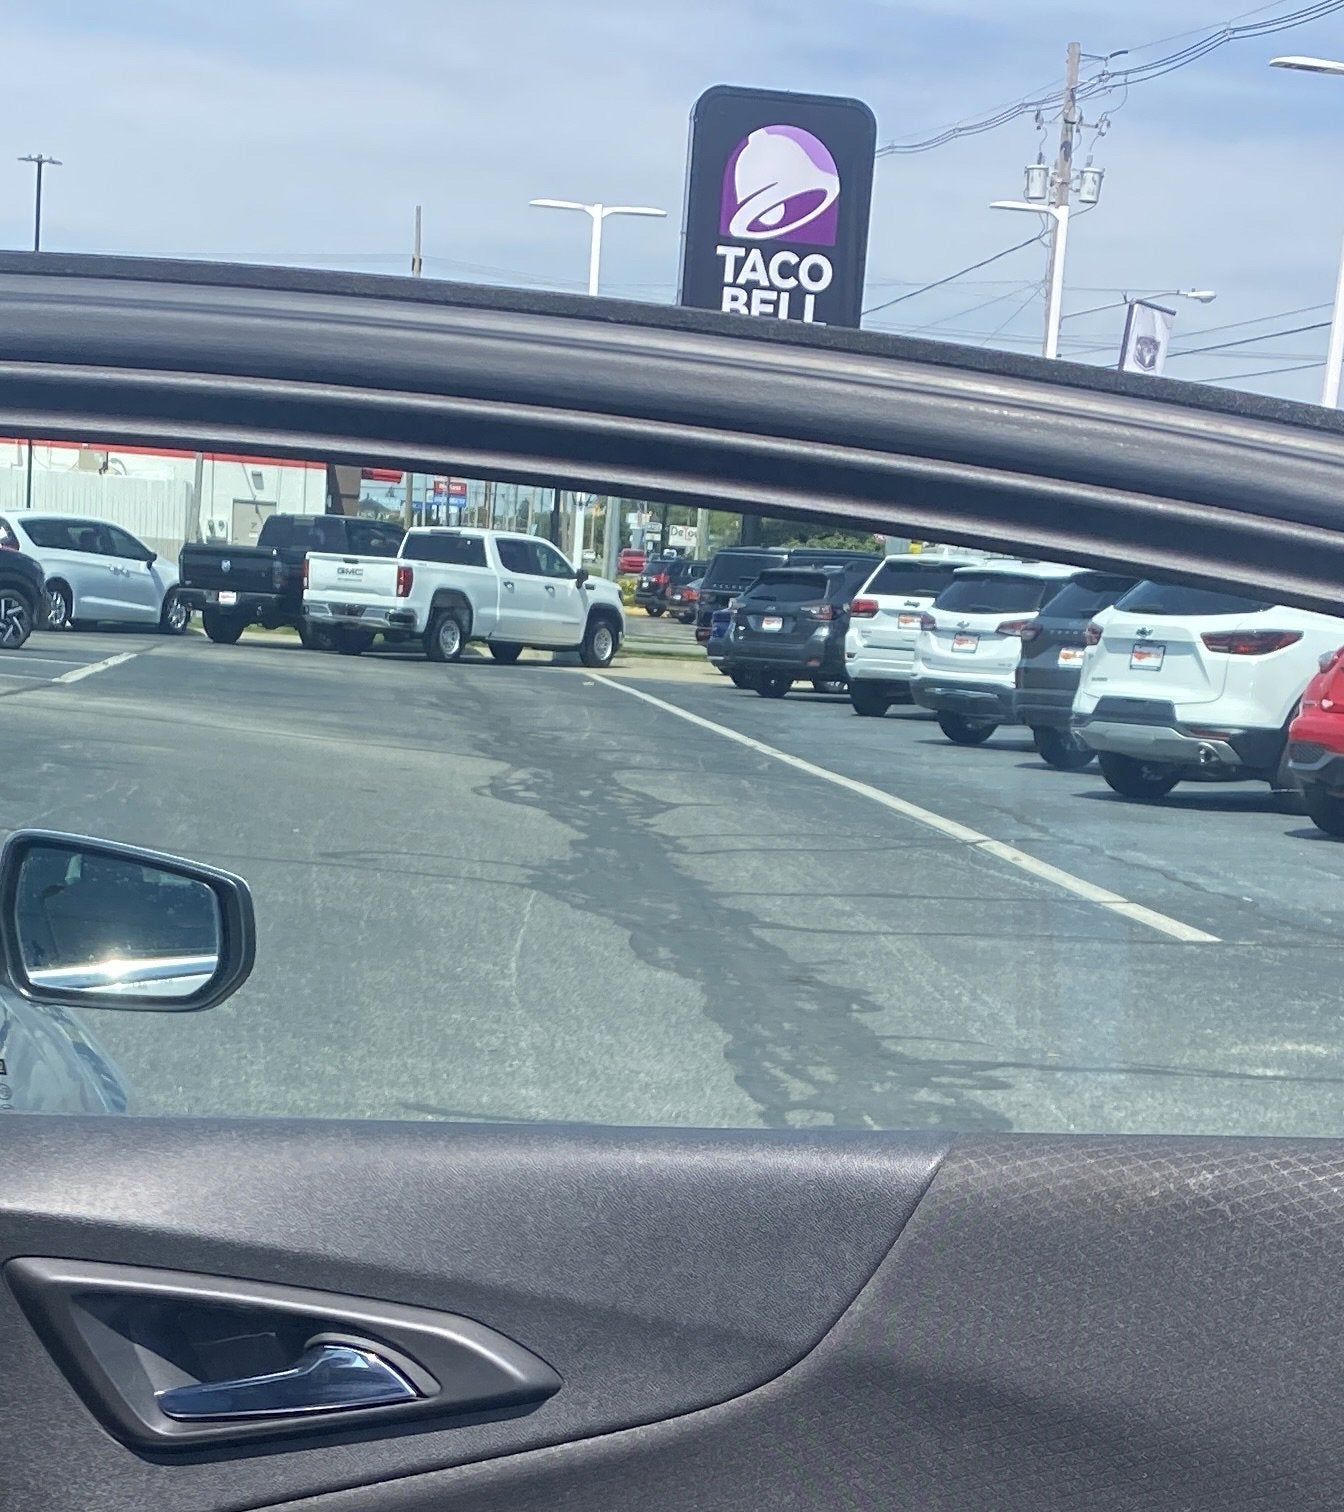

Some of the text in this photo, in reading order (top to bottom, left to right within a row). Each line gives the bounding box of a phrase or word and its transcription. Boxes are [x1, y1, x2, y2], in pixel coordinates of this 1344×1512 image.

[716, 244, 833, 292] TACO
[721, 286, 827, 326] BELL
[337, 567, 364, 576] GMC
